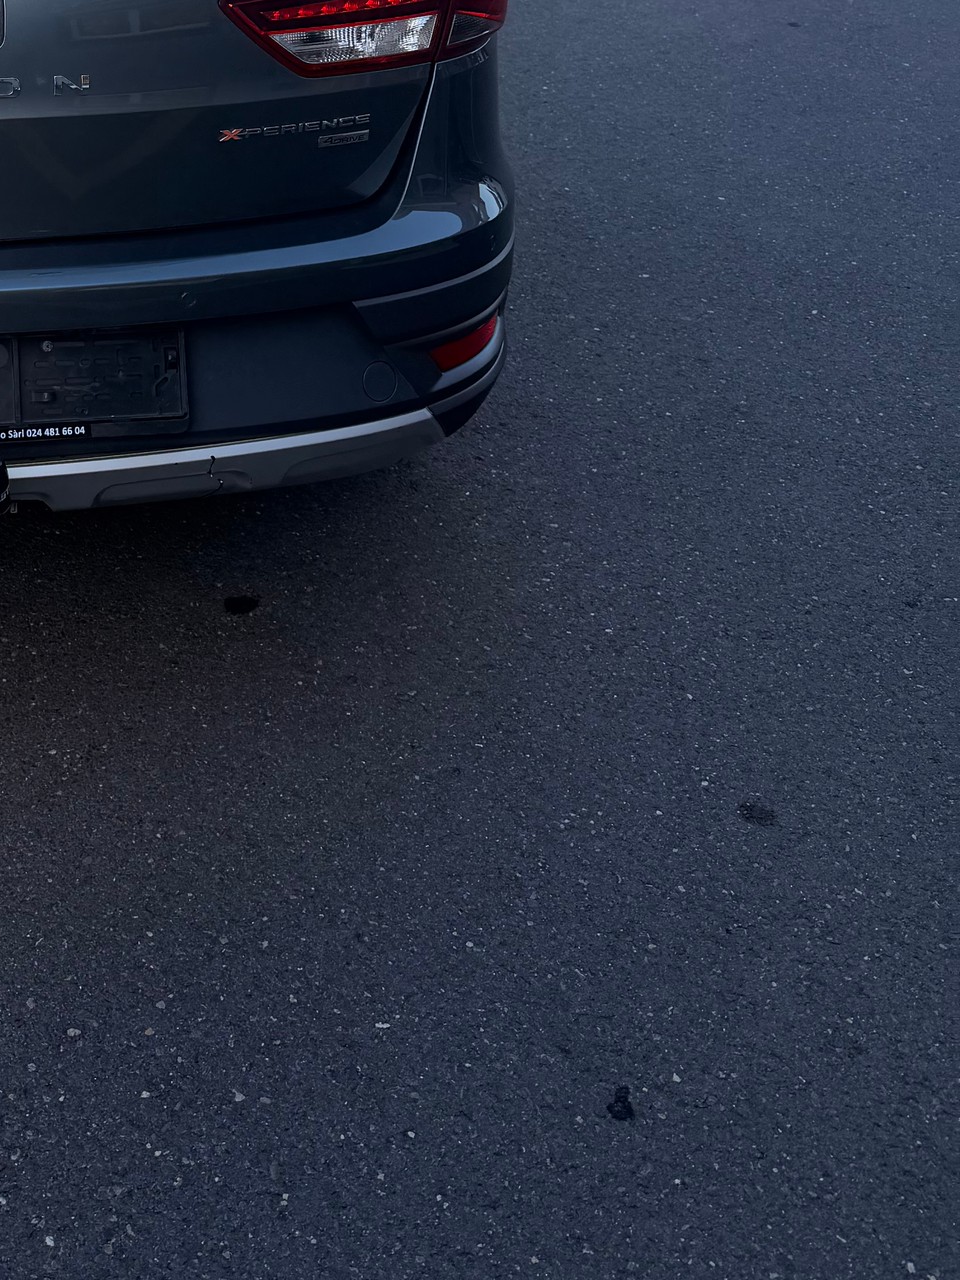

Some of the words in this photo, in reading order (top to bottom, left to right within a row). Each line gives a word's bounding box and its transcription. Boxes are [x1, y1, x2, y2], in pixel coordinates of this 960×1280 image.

[219, 113, 371, 142] XPERIENCE
[322, 134, 365, 145] 4DRIVE
[8, 426, 25, 438] Sàrl
[26, 428, 42, 437] 024
[43, 427, 60, 437] 481
[62, 427, 73, 436] 66
[74, 426, 86, 435] 04
